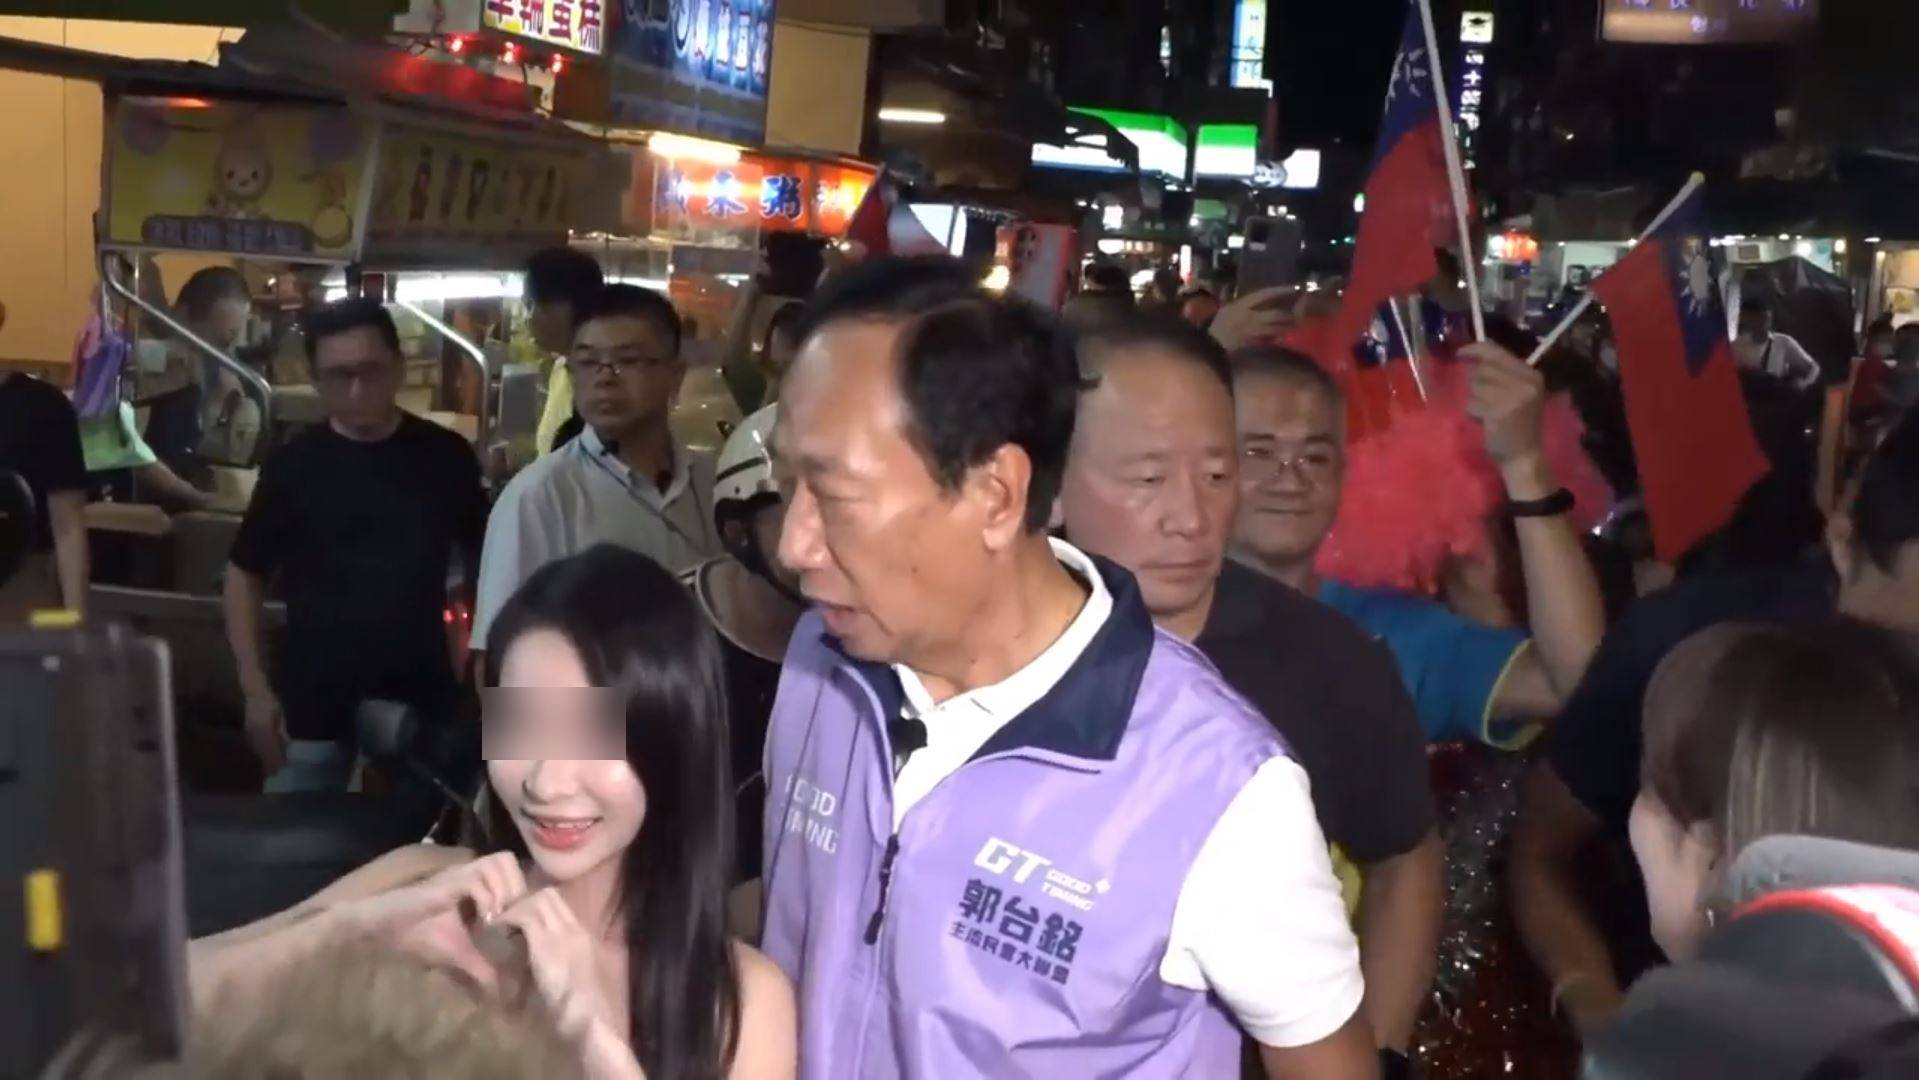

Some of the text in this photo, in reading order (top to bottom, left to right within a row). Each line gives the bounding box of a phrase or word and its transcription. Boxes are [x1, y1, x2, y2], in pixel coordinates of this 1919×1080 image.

[974, 836, 1052, 884] GT
[1046, 868, 1092, 894] GOOD
[958, 878, 1084, 963] 郭台銘
